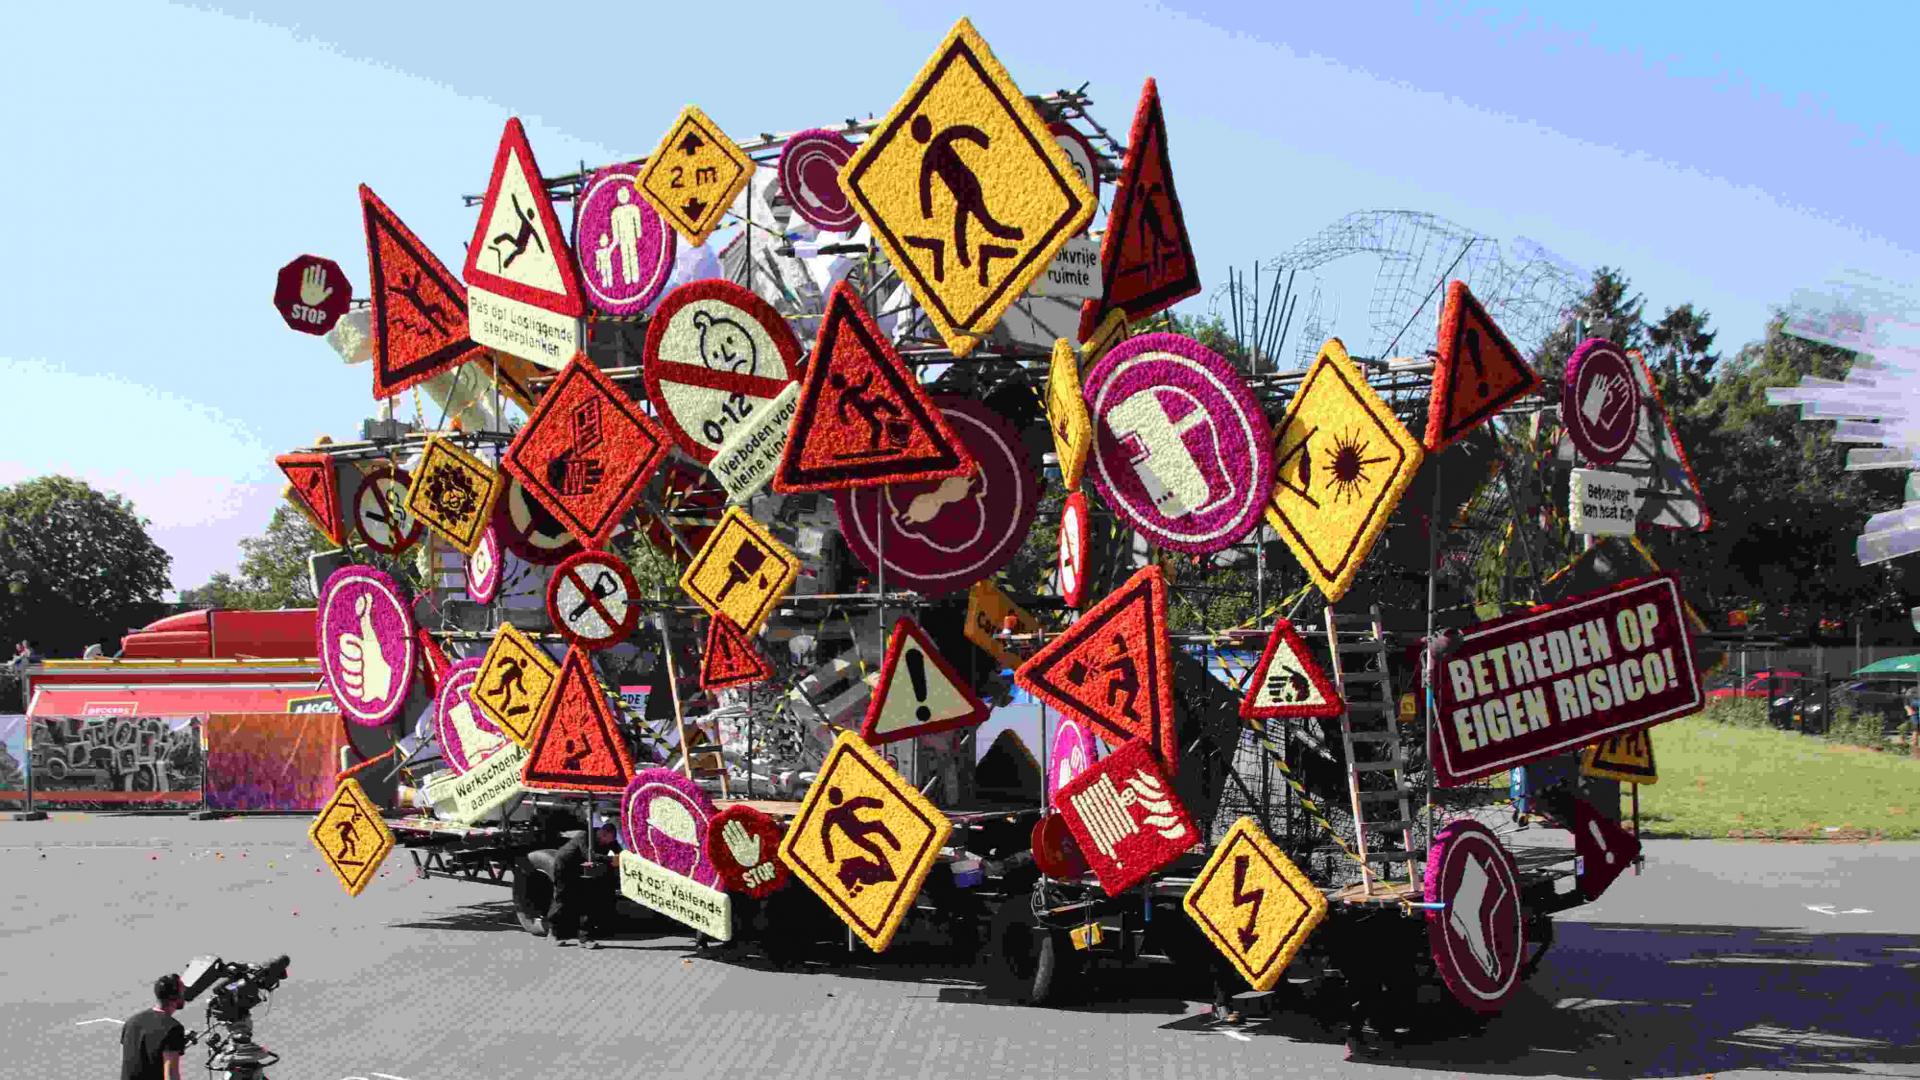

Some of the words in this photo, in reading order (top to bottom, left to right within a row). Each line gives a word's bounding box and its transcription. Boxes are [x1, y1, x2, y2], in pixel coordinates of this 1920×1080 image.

[671, 166, 685, 188] 2
[696, 167, 717, 185] m
[1056, 248, 1096, 268] okvrije
[1048, 267, 1089, 285] ruimte
[291, 304, 327, 324] STOP
[471, 296, 489, 315] Pas
[492, 306, 507, 320] op!
[484, 321, 560, 356] steigerplanken
[703, 393, 753, 444] 0-12
[719, 423, 774, 477] Verboden
[772, 397, 797, 426] voor
[729, 460, 766, 494] kleine
[1448, 617, 1612, 702] BETREDEN
[1616, 603, 1659, 652] OP
[1452, 686, 1551, 753] EIGEN
[1553, 648, 1679, 722] RISICO!
[455, 747, 530, 798] Werkschoenn
[470, 771, 521, 810] aanbevole
[623, 863, 643, 882] Let
[742, 862, 775, 889] STOP
